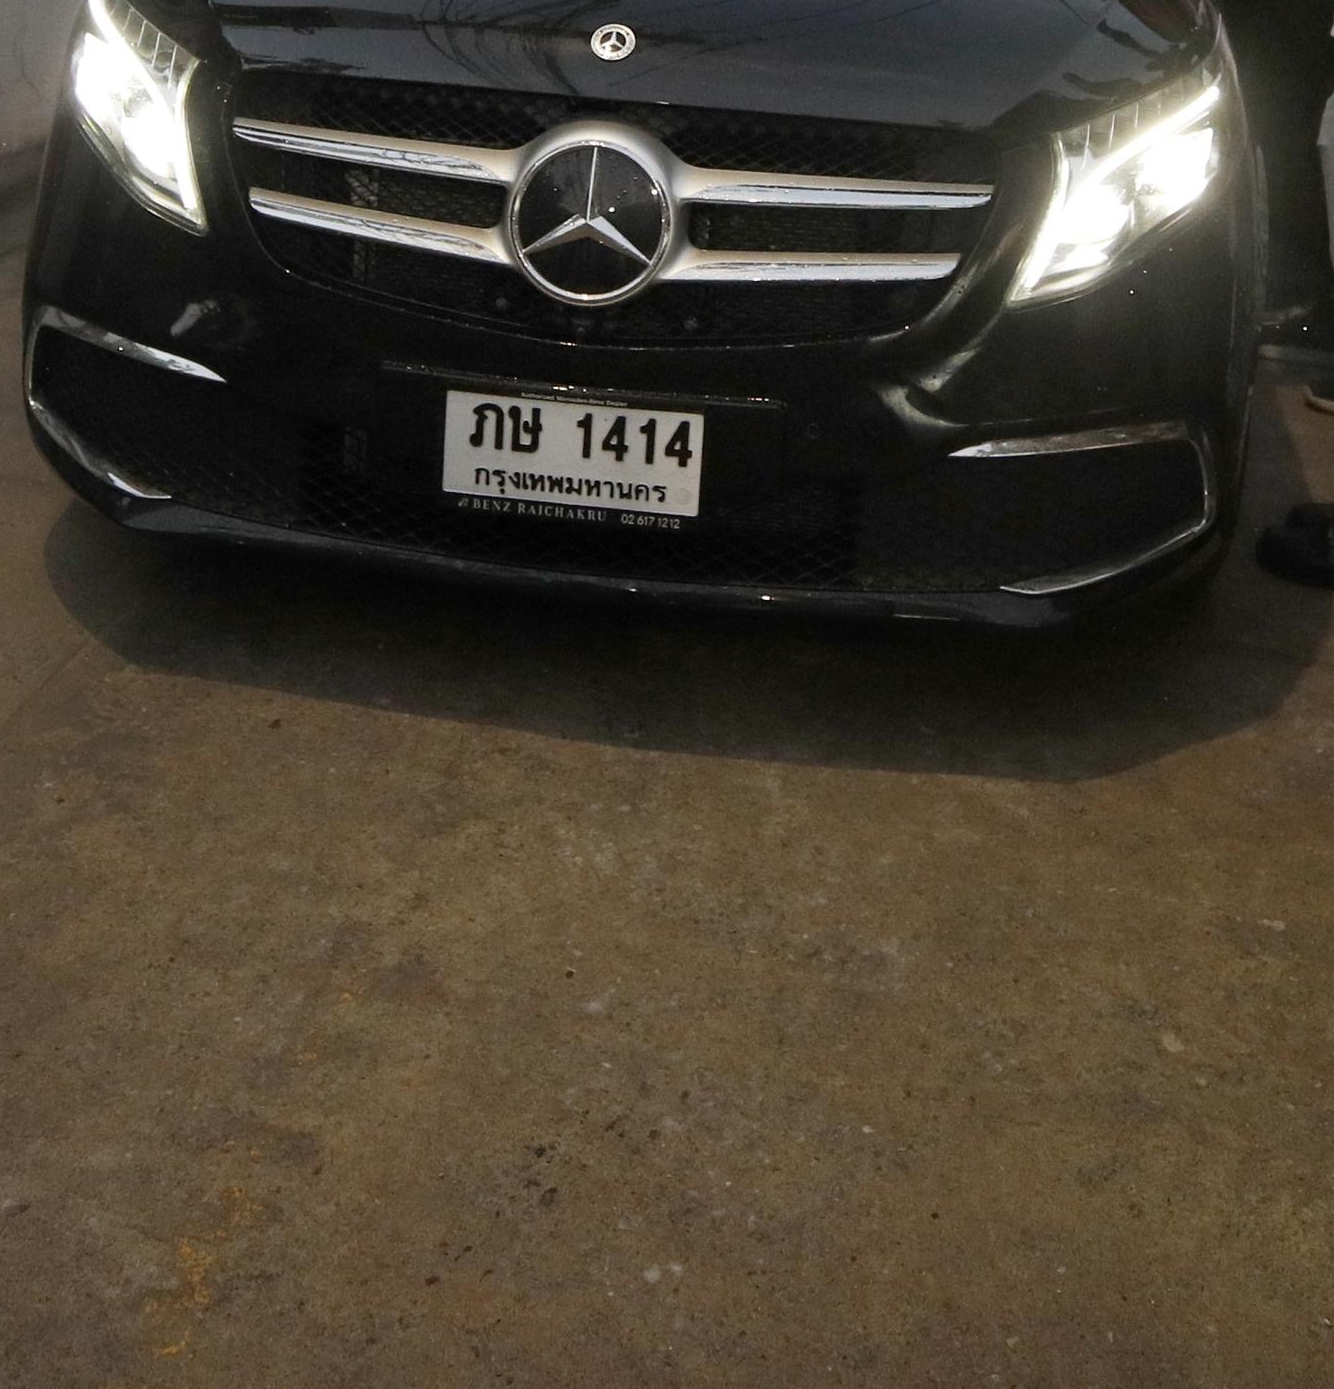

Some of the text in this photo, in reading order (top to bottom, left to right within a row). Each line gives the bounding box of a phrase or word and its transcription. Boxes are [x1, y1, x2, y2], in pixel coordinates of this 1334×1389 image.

[469, 402, 693, 468] ภษ 1414
[474, 467, 668, 502] กรุงเทพมหานคร
[473, 498, 511, 512] BENZ
[620, 514, 634, 526] 02
[636, 515, 655, 528] 617
[657, 516, 681, 530] 1212
